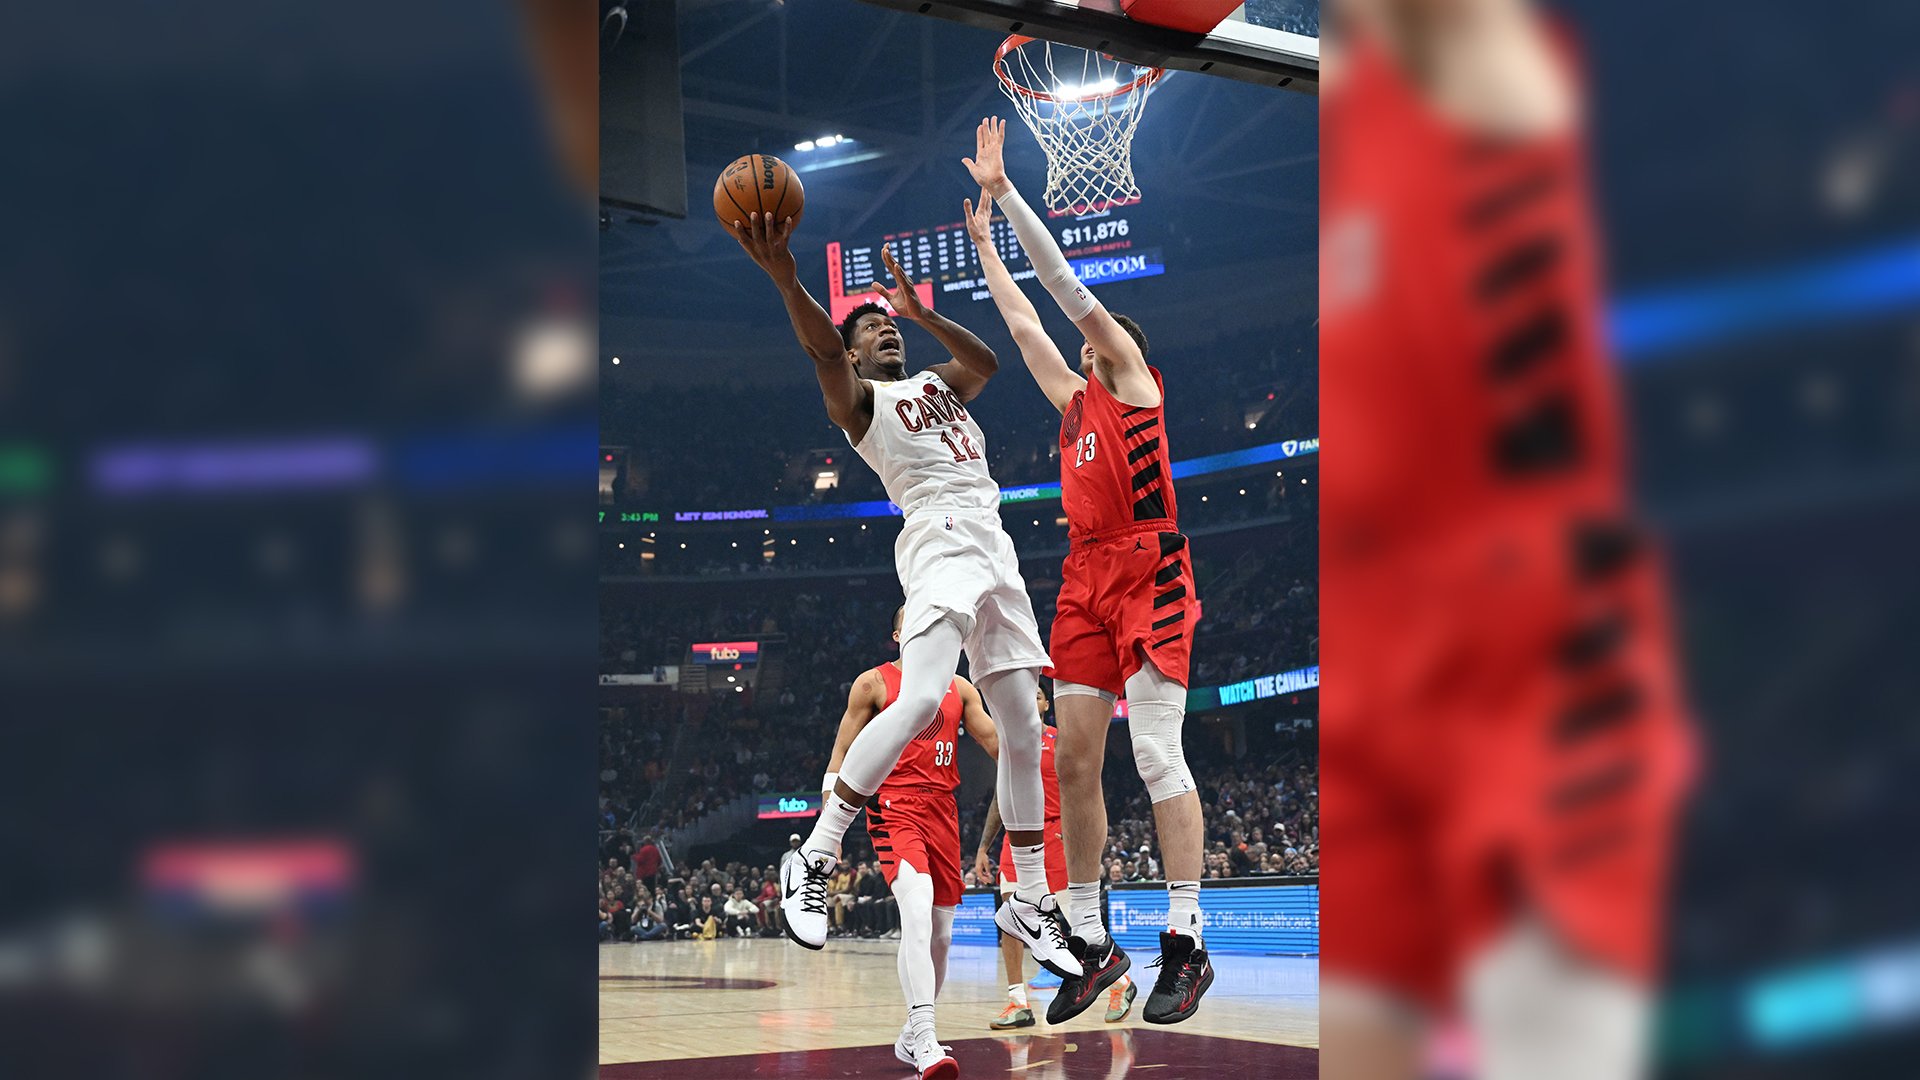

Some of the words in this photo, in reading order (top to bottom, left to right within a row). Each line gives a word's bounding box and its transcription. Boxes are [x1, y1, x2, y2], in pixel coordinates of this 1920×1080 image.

[1062, 219, 1129, 247] $11,876
[895, 390, 968, 433] CAVS
[940, 429, 981, 463] 12
[1075, 431, 1096, 468] 23
[999, 487, 1039, 501] ETWORK
[642, 512, 659, 522] PM
[710, 647, 740, 661] fubo
[1219, 680, 1256, 706] WATCH
[1254, 675, 1276, 699] THE
[934, 740, 954, 767] 33
[778, 797, 808, 813] fubo
[1128, 909, 1169, 926] Clevelan
[1215, 911, 1252, 929] Official
[1254, 911, 1312, 930] Healthcare
